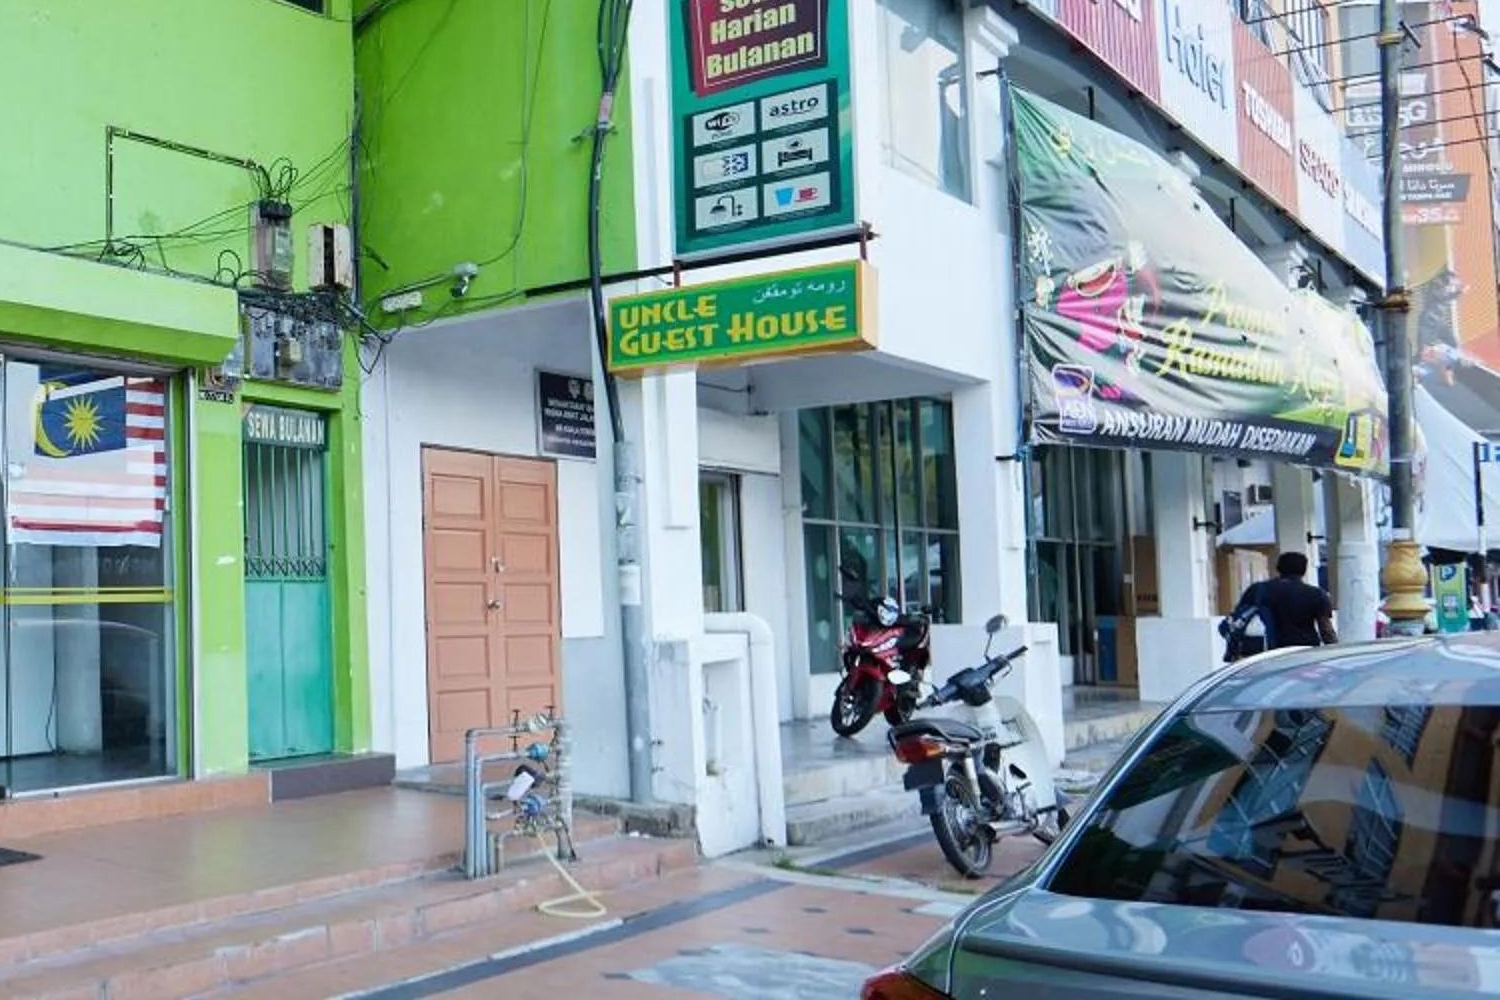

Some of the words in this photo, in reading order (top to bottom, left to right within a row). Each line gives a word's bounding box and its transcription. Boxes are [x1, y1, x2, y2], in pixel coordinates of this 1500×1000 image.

[710, 3, 796, 45] Harian
[706, 31, 814, 79] Bulanan
[769, 97, 819, 117] astro
[619, 294, 717, 329] UNCLE
[619, 323, 719, 356] GUEST
[727, 305, 847, 344] HOUSE
[246, 411, 277, 440] SEWA
[1100, 412, 1184, 441] ANSURAN
[1181, 417, 1240, 447] MUDAH
